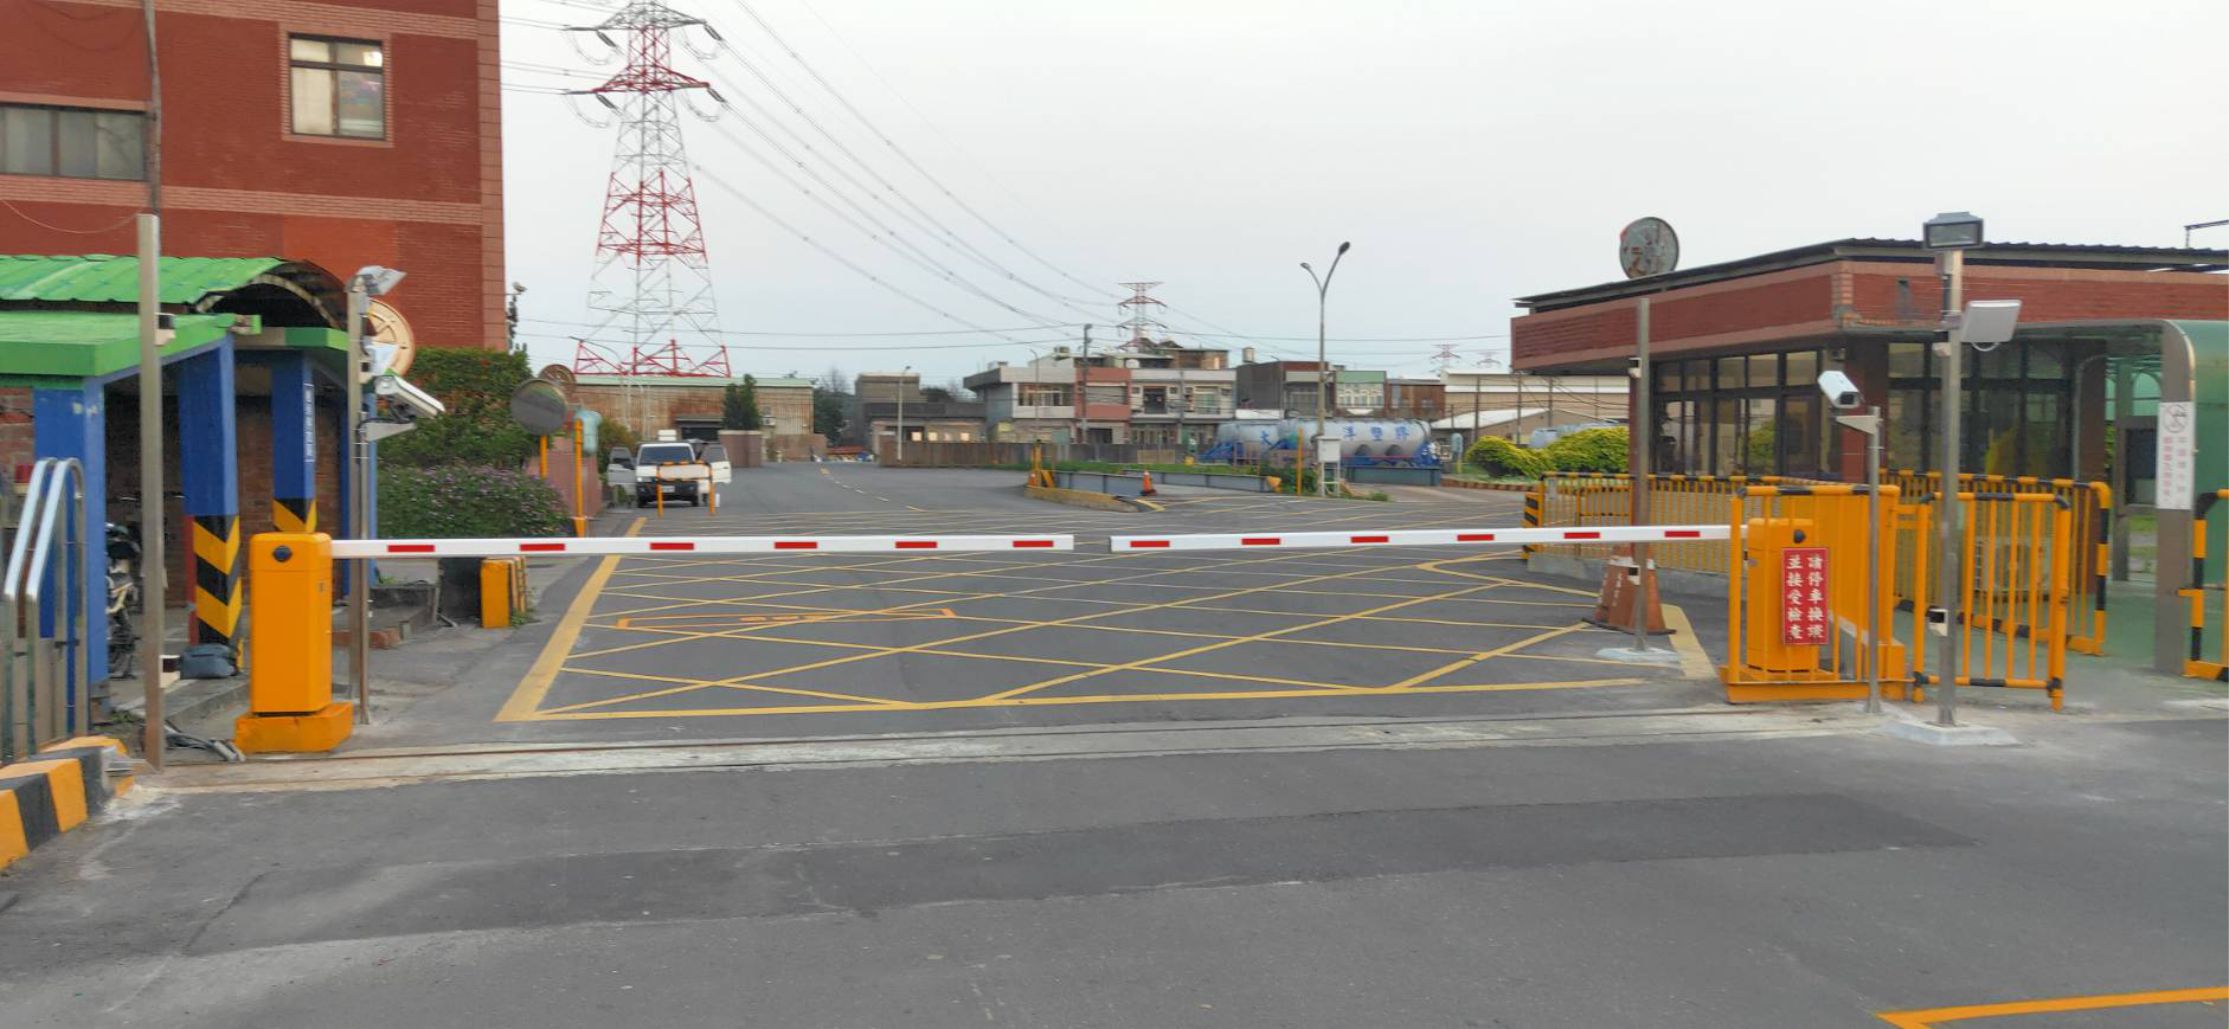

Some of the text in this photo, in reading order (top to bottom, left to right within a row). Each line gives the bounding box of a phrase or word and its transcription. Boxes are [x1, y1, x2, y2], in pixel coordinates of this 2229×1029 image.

[1787, 553, 1804, 640] 並接受檢查
